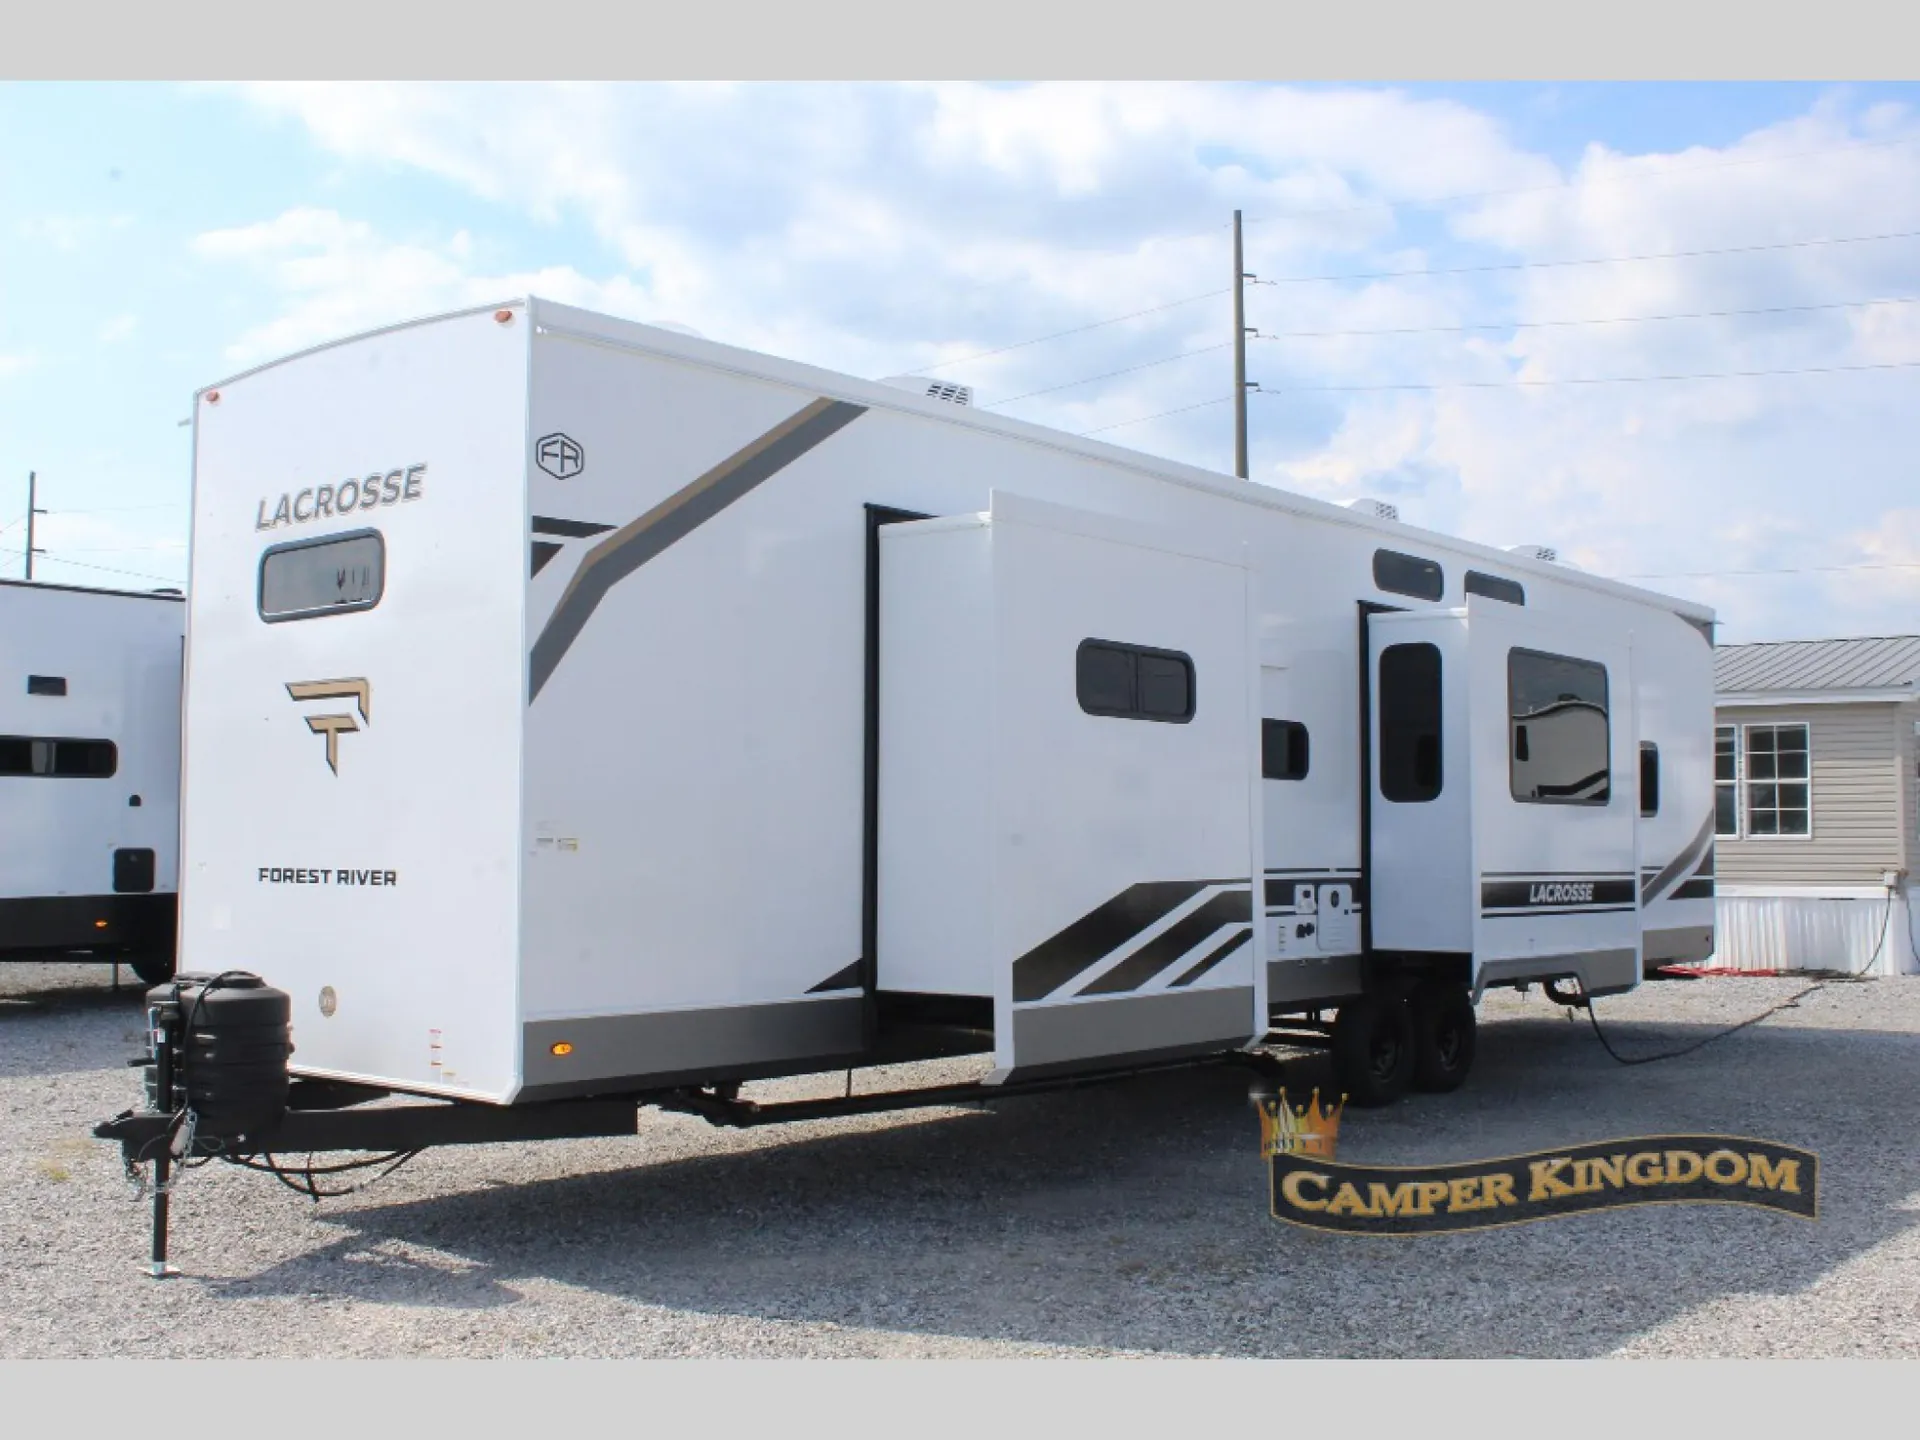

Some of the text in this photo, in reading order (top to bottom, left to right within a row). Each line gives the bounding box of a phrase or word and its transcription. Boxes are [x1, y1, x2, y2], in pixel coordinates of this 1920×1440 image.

[255, 462, 427, 532] LACROSSE
[258, 867, 397, 886] FOREST RIVER
[1529, 882, 1595, 903] LACROSSE
